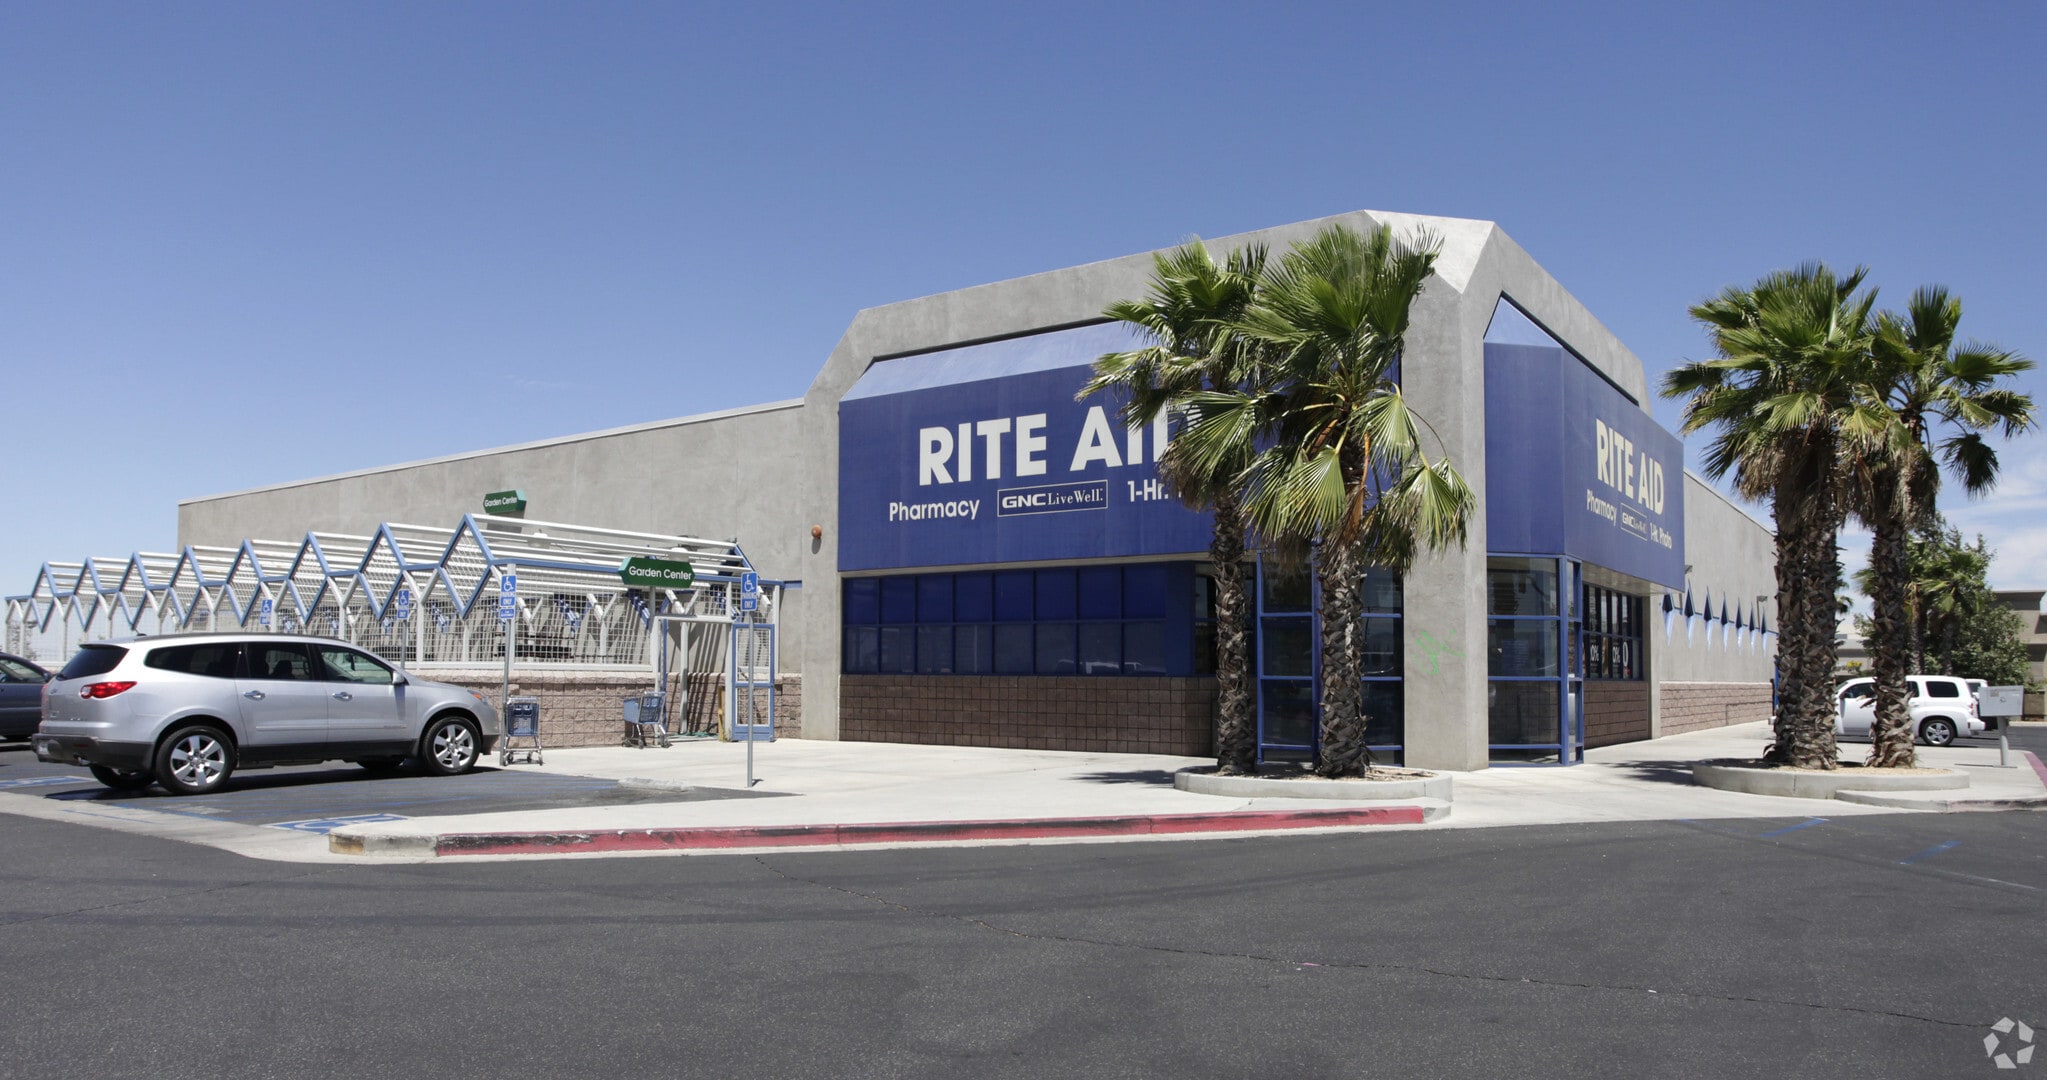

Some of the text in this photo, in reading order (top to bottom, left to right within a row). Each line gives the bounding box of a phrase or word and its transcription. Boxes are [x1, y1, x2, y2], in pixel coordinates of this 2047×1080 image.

[919, 413, 1047, 486] RITE
[1596, 418, 1664, 515] RITE AID
[484, 496, 518, 507] Garden Center
[889, 499, 980, 522] Pharmacy
[1002, 493, 1046, 509] GNC
[1127, 478, 1169, 502] 1-Hr.
[1586, 489, 1617, 527] Pharmacy
[628, 565, 692, 580] Garden Center
